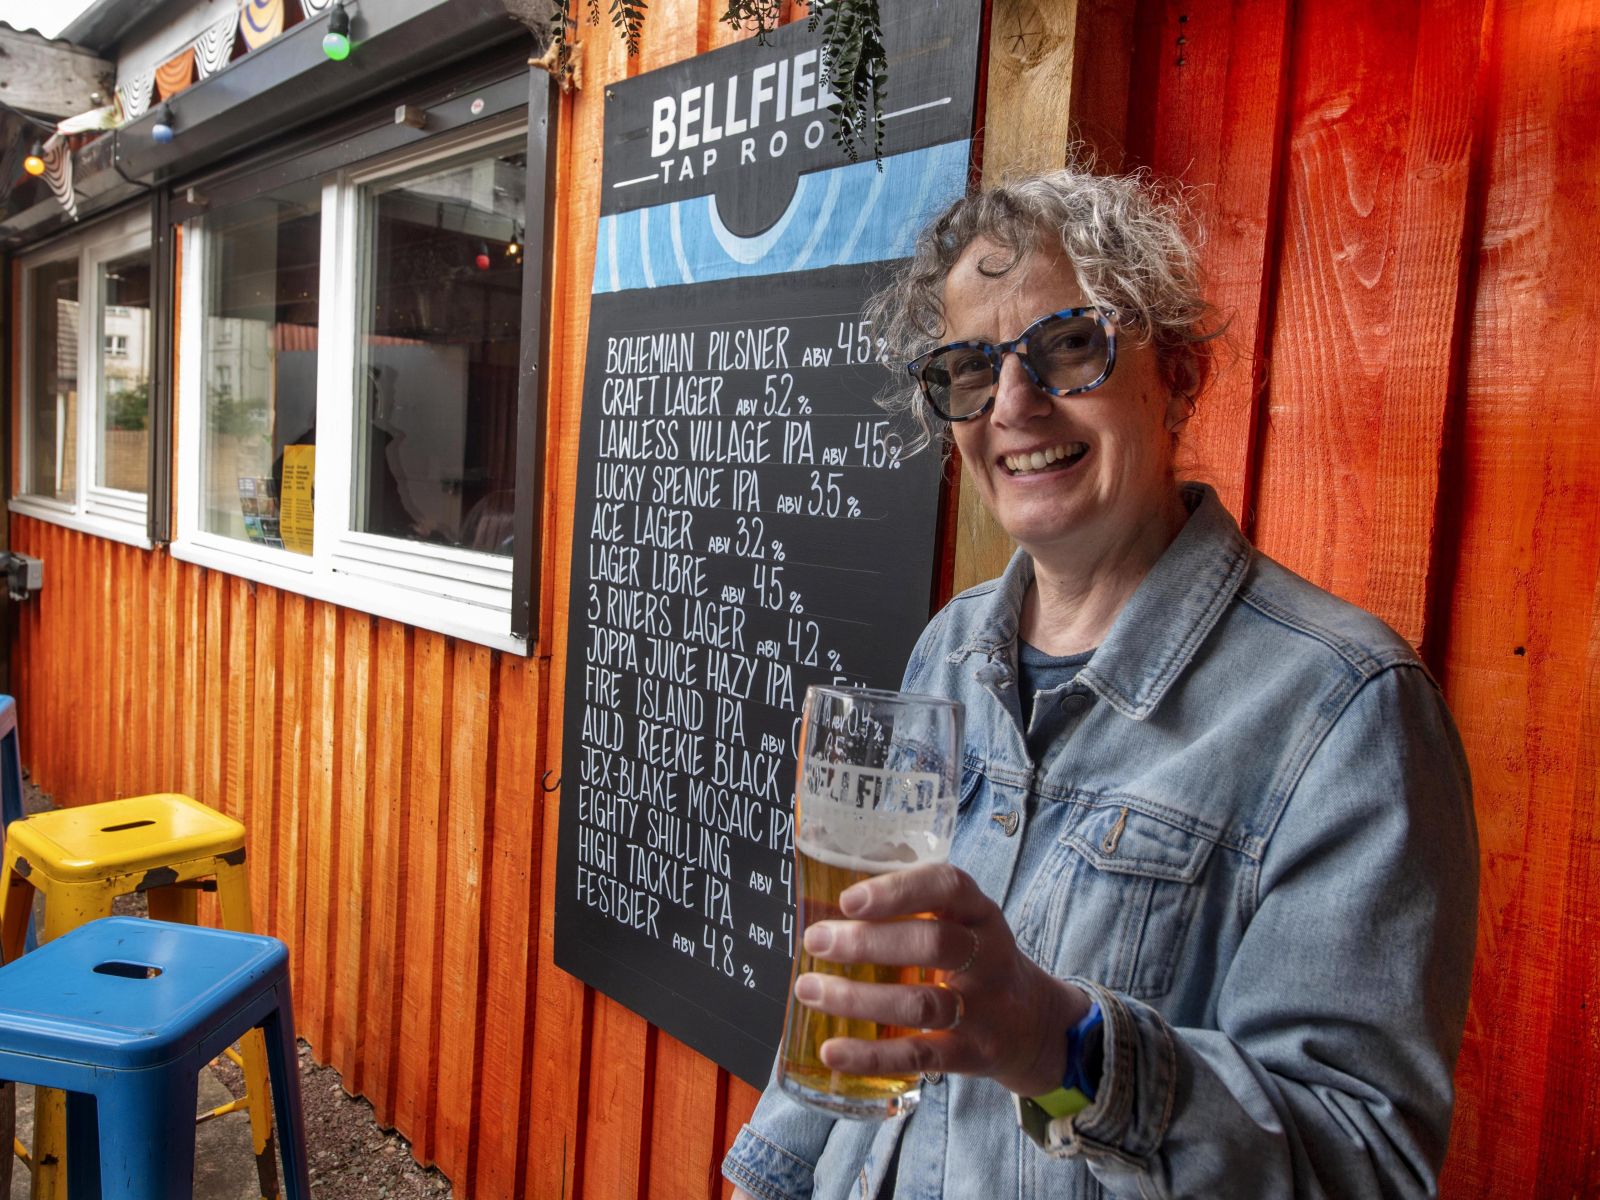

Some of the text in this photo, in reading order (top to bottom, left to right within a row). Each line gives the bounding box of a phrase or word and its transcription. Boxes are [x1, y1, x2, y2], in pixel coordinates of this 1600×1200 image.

[651, 44, 864, 158] BELLFIEL
[660, 115, 850, 184] TAP ROO
[605, 332, 694, 375] BOHEMIAN
[707, 326, 790, 370] PILSNER
[802, 347, 832, 367] ABV
[602, 375, 660, 416] CRAFT
[665, 375, 723, 416] LAGER
[735, 399, 758, 416] ABV
[599, 419, 678, 461] LAWLESS
[690, 420, 771, 464] VILLAGE
[783, 420, 814, 464] IPA
[821, 446, 847, 466] ABV
[591, 503, 625, 542] ACE
[634, 505, 693, 550] LAGER
[708, 536, 731, 554] ABV
[595, 462, 646, 503] LUCKY
[653, 465, 725, 508] SPENCE
[733, 468, 760, 513] IPA
[777, 494, 802, 514] ABV
[589, 543, 640, 588] LAGER
[652, 552, 708, 598] LIBRE
[721, 584, 746, 605] ABV
[588, 583, 601, 620] 3
[607, 586, 672, 637] RIVERS
[683, 598, 746, 652] LAGER
[756, 639, 781, 660] ABV
[587, 624, 638, 674] JOPPA
[645, 637, 698, 686] JUICE
[707, 649, 758, 699] HAZY
[765, 661, 795, 712] IPA
[585, 664, 622, 710] FIRE
[636, 676, 704, 731] ISLAND
[715, 696, 746, 747] IPA
[761, 732, 785, 756] ABV
[582, 704, 624, 751] AULD
[638, 719, 705, 776] REEKIE
[712, 740, 780, 803] BLACK
[579, 784, 639, 839] EIGHTY
[647, 808, 731, 880] SHILLING
[750, 871, 772, 895] ABV
[581, 745, 796, 858] JEX-BLAKE MOSAIC IPA
[577, 865, 660, 939] FESTBIER
[672, 933, 695, 958] ABV
[579, 825, 617, 877] HIGH
[626, 844, 695, 909] TACKLE
[705, 874, 734, 929] IPA
[749, 923, 774, 950] ABV
